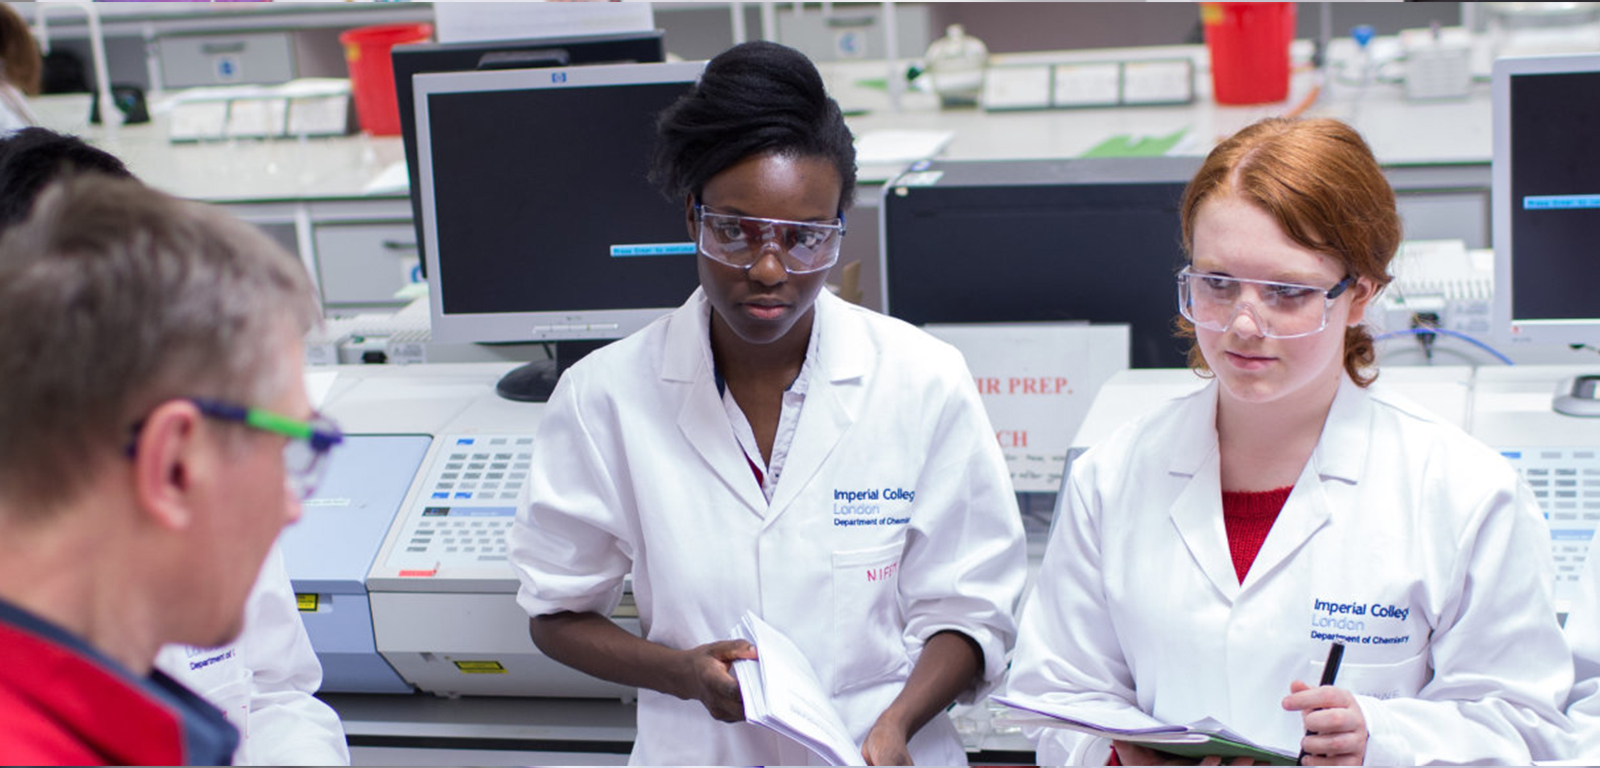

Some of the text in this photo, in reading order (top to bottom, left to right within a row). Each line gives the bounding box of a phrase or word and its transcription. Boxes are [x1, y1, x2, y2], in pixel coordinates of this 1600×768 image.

[1009, 377, 1073, 395] PREP.
[834, 487, 915, 503] Imperial Colleg
[833, 503, 879, 515] London
[833, 518, 877, 527] Department
[1314, 598, 1410, 621] Imperial Colleg
[1311, 613, 1365, 631] London
[1362, 635, 1371, 644] of
